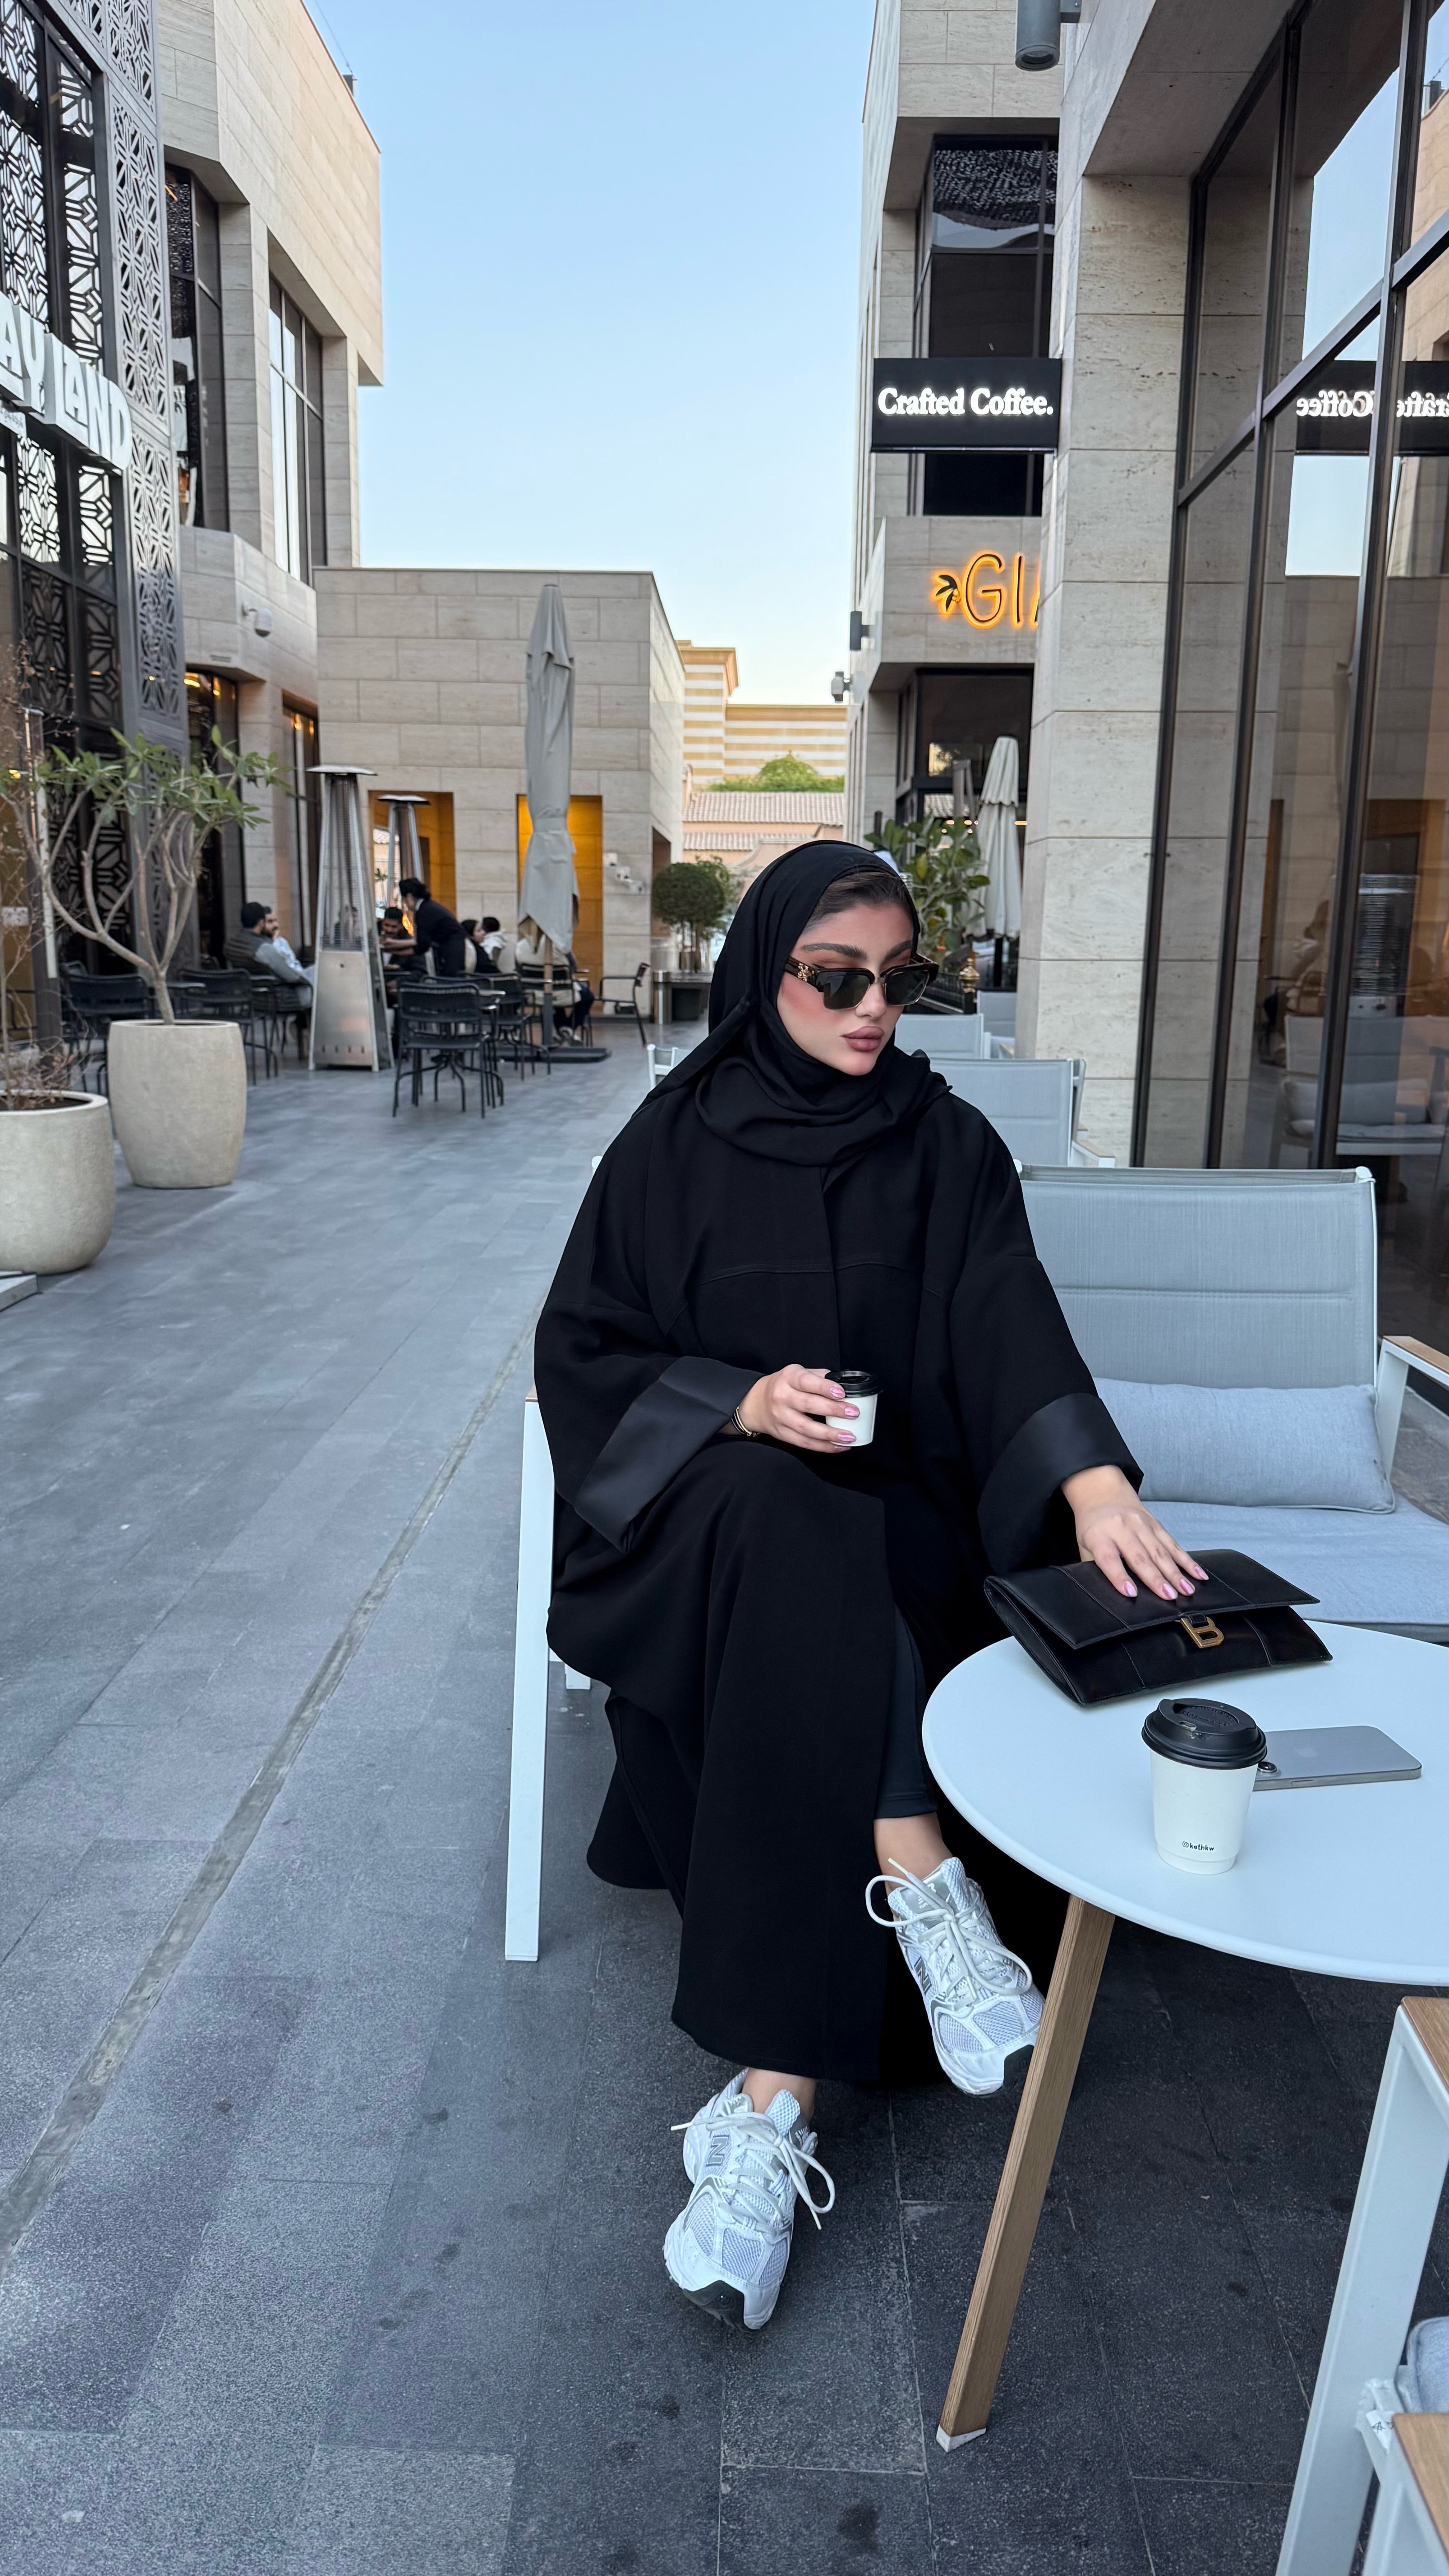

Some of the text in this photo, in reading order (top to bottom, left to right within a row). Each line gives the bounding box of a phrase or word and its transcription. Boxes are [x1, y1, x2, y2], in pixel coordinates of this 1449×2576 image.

[878, 387, 1053, 415] Crafted Coffee.
[962, 552, 1039, 628] GI
